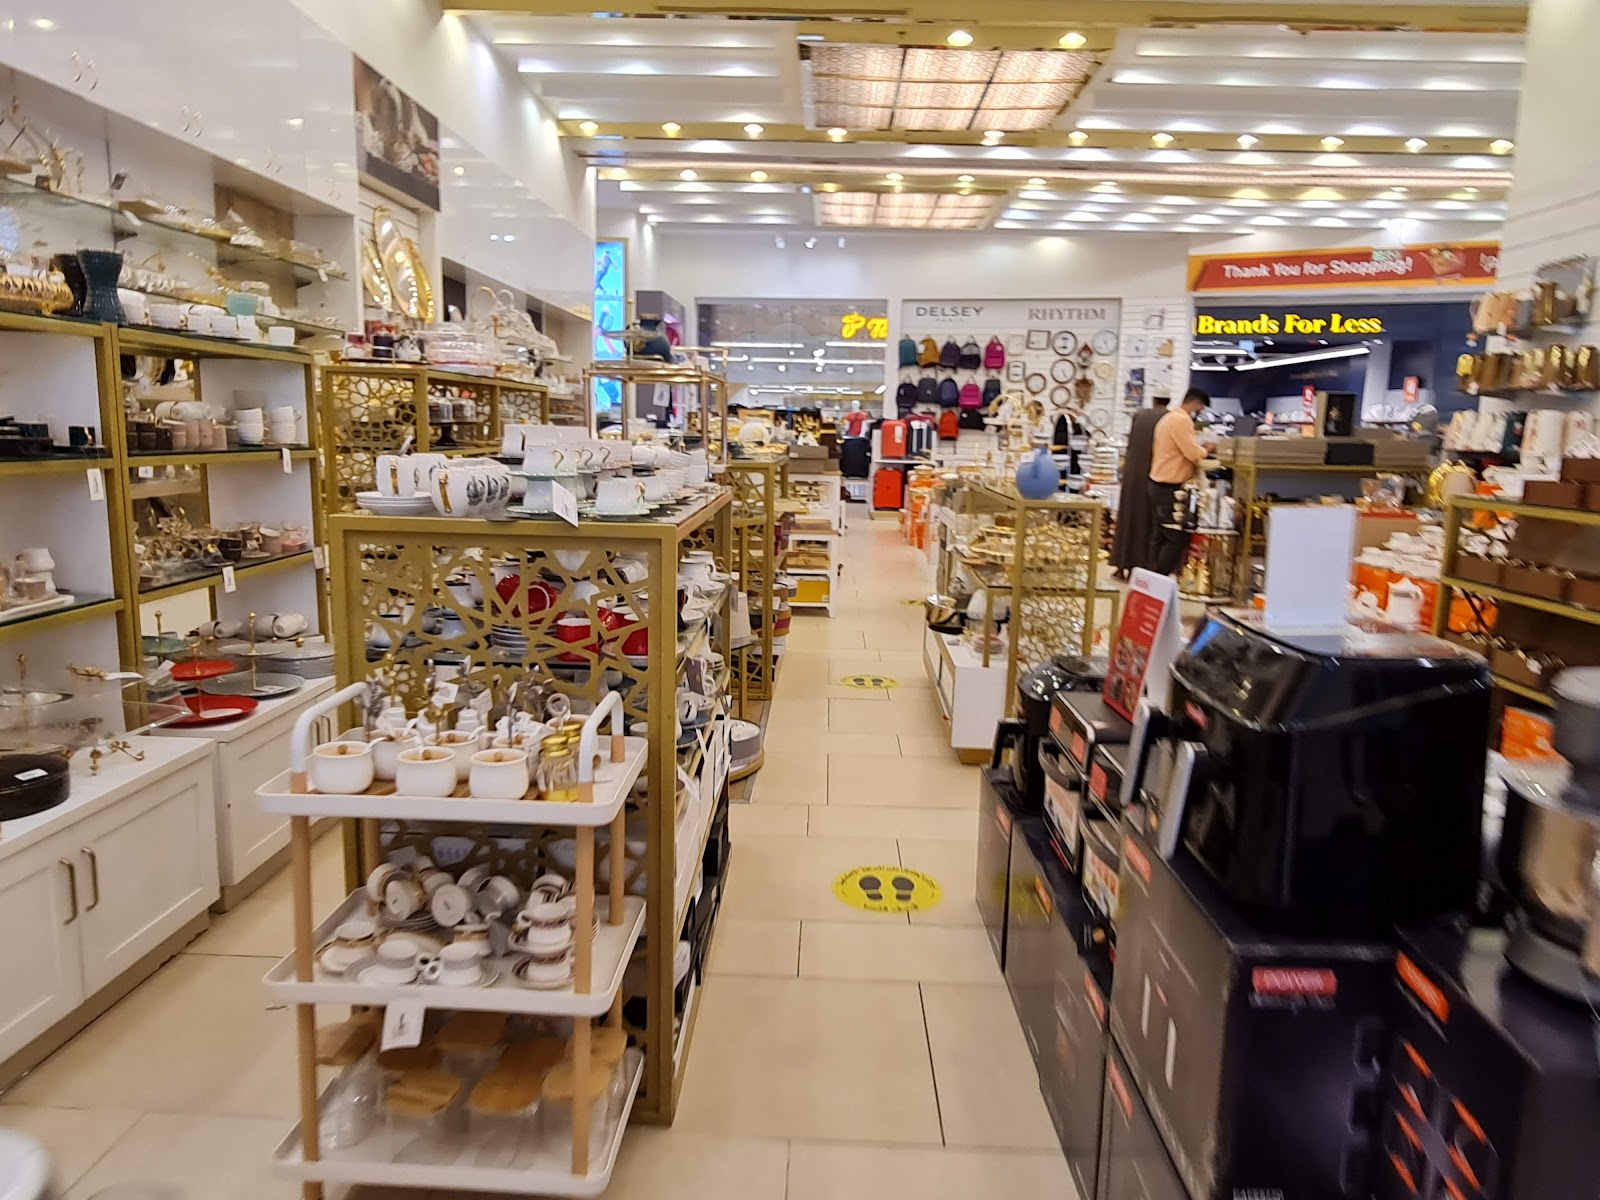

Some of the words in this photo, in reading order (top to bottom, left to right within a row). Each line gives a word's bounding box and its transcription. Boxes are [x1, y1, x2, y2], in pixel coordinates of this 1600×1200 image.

[1222, 263, 1271, 279] Thank
[1272, 262, 1302, 277] You
[1303, 261, 1328, 276] for
[915, 306, 985, 317] DELSEY
[1028, 308, 1107, 321] RHYTHM
[1197, 313, 1280, 335] Brands
[1283, 313, 1327, 334] For
[1329, 313, 1383, 334] Less
